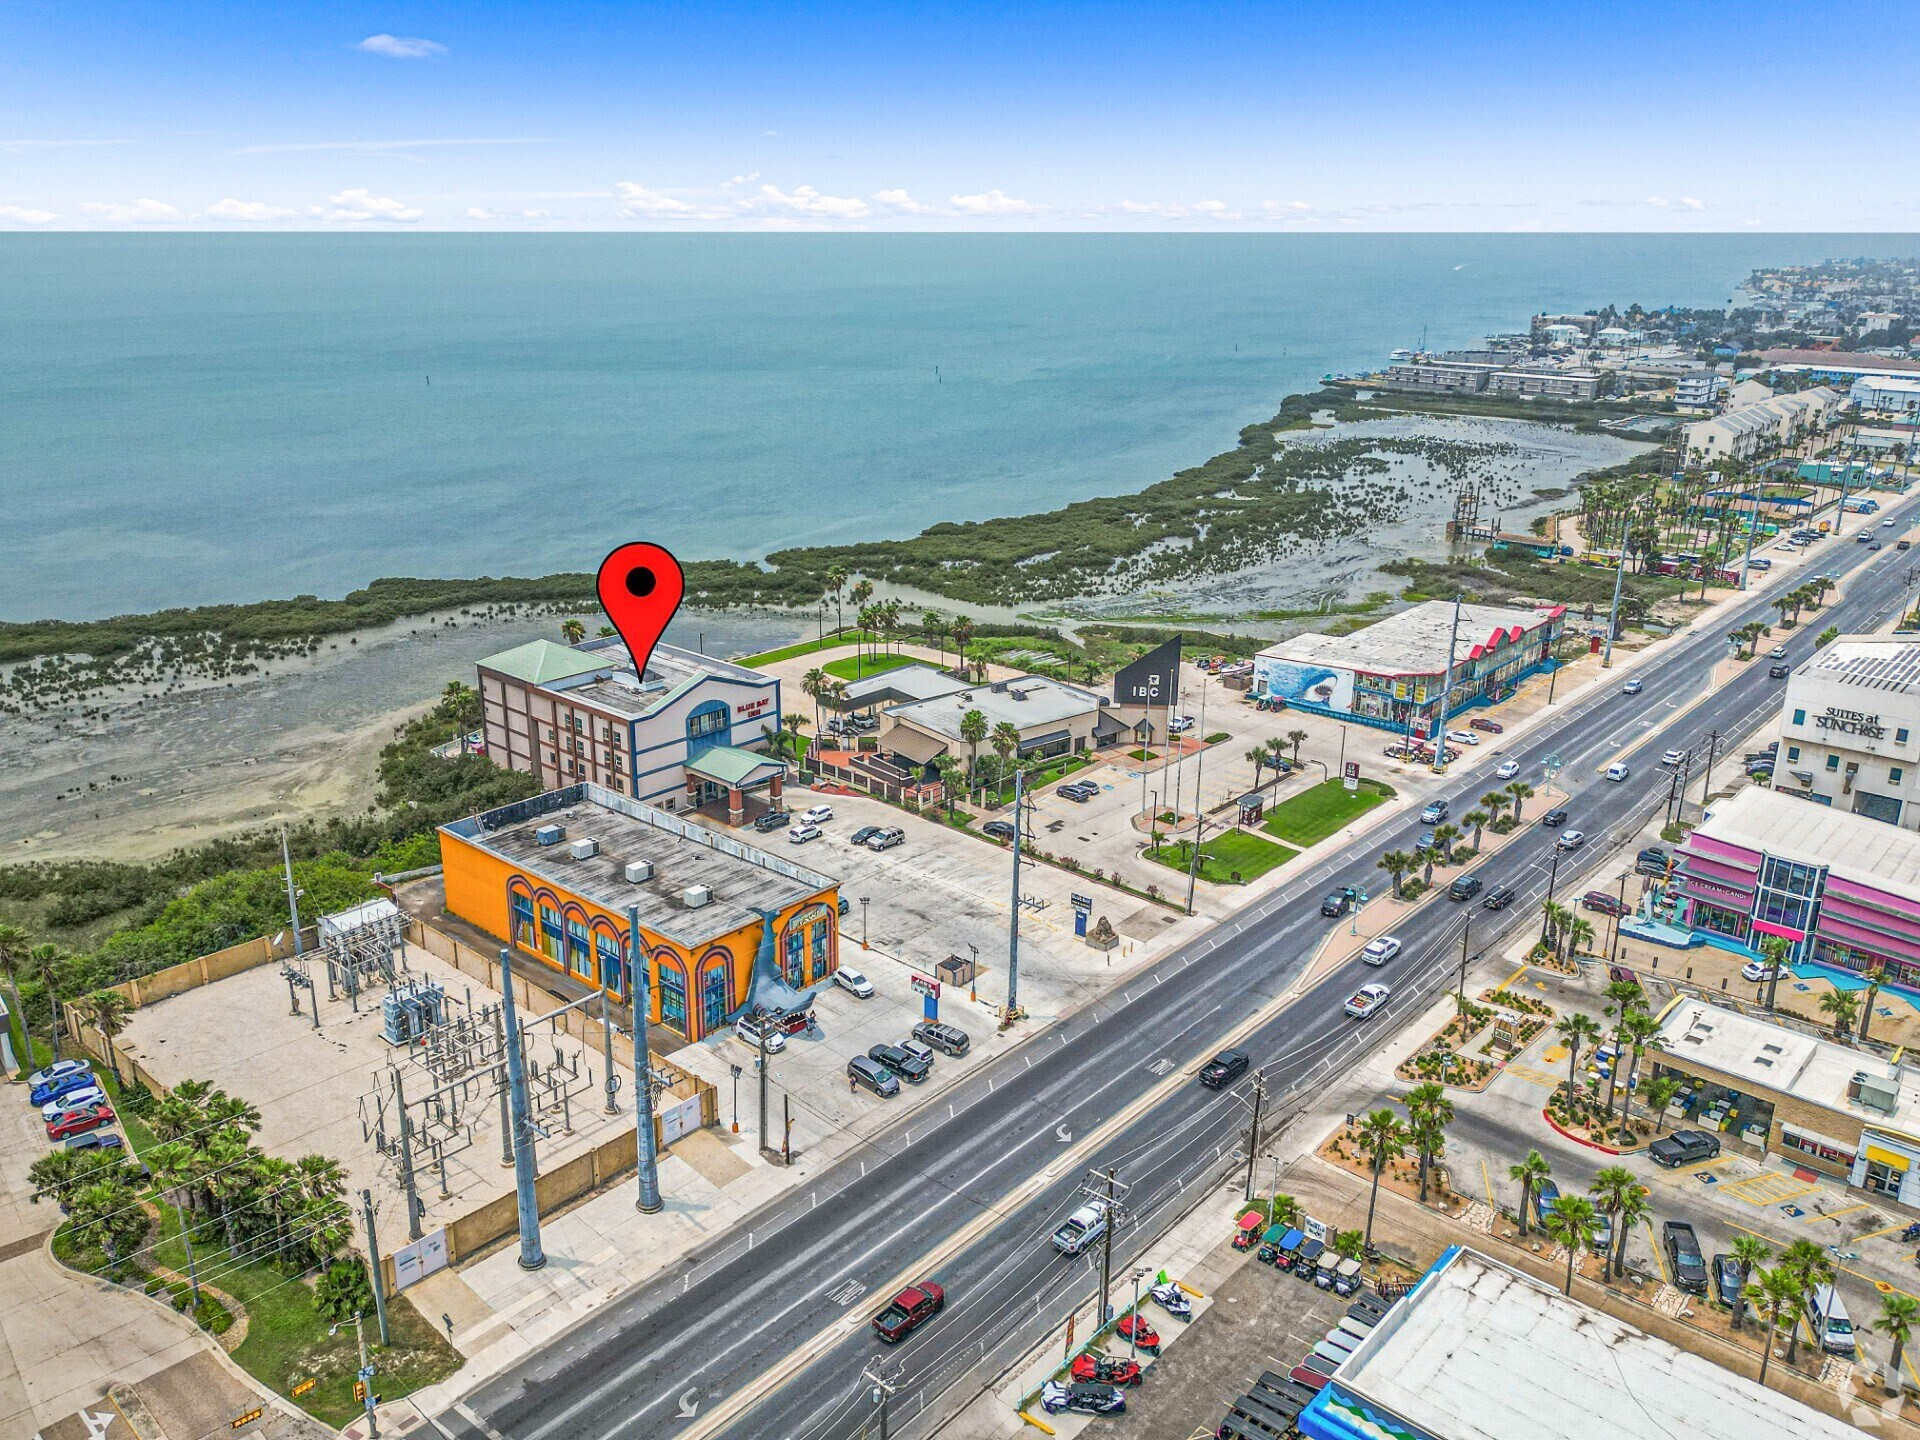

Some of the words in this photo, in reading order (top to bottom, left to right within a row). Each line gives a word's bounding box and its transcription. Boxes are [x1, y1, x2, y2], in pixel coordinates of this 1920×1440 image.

[1132, 686, 1160, 697] IBC
[737, 701, 756, 714] BLUE
[756, 697, 770, 708] BAY
[748, 709, 761, 718] INN
[1826, 707, 1865, 722] SUITES
[1865, 714, 1880, 725] at
[1816, 717, 1886, 740] SUNCHASE
[1699, 883, 1723, 893] CREAM
[1725, 890, 1747, 899] CANDY
